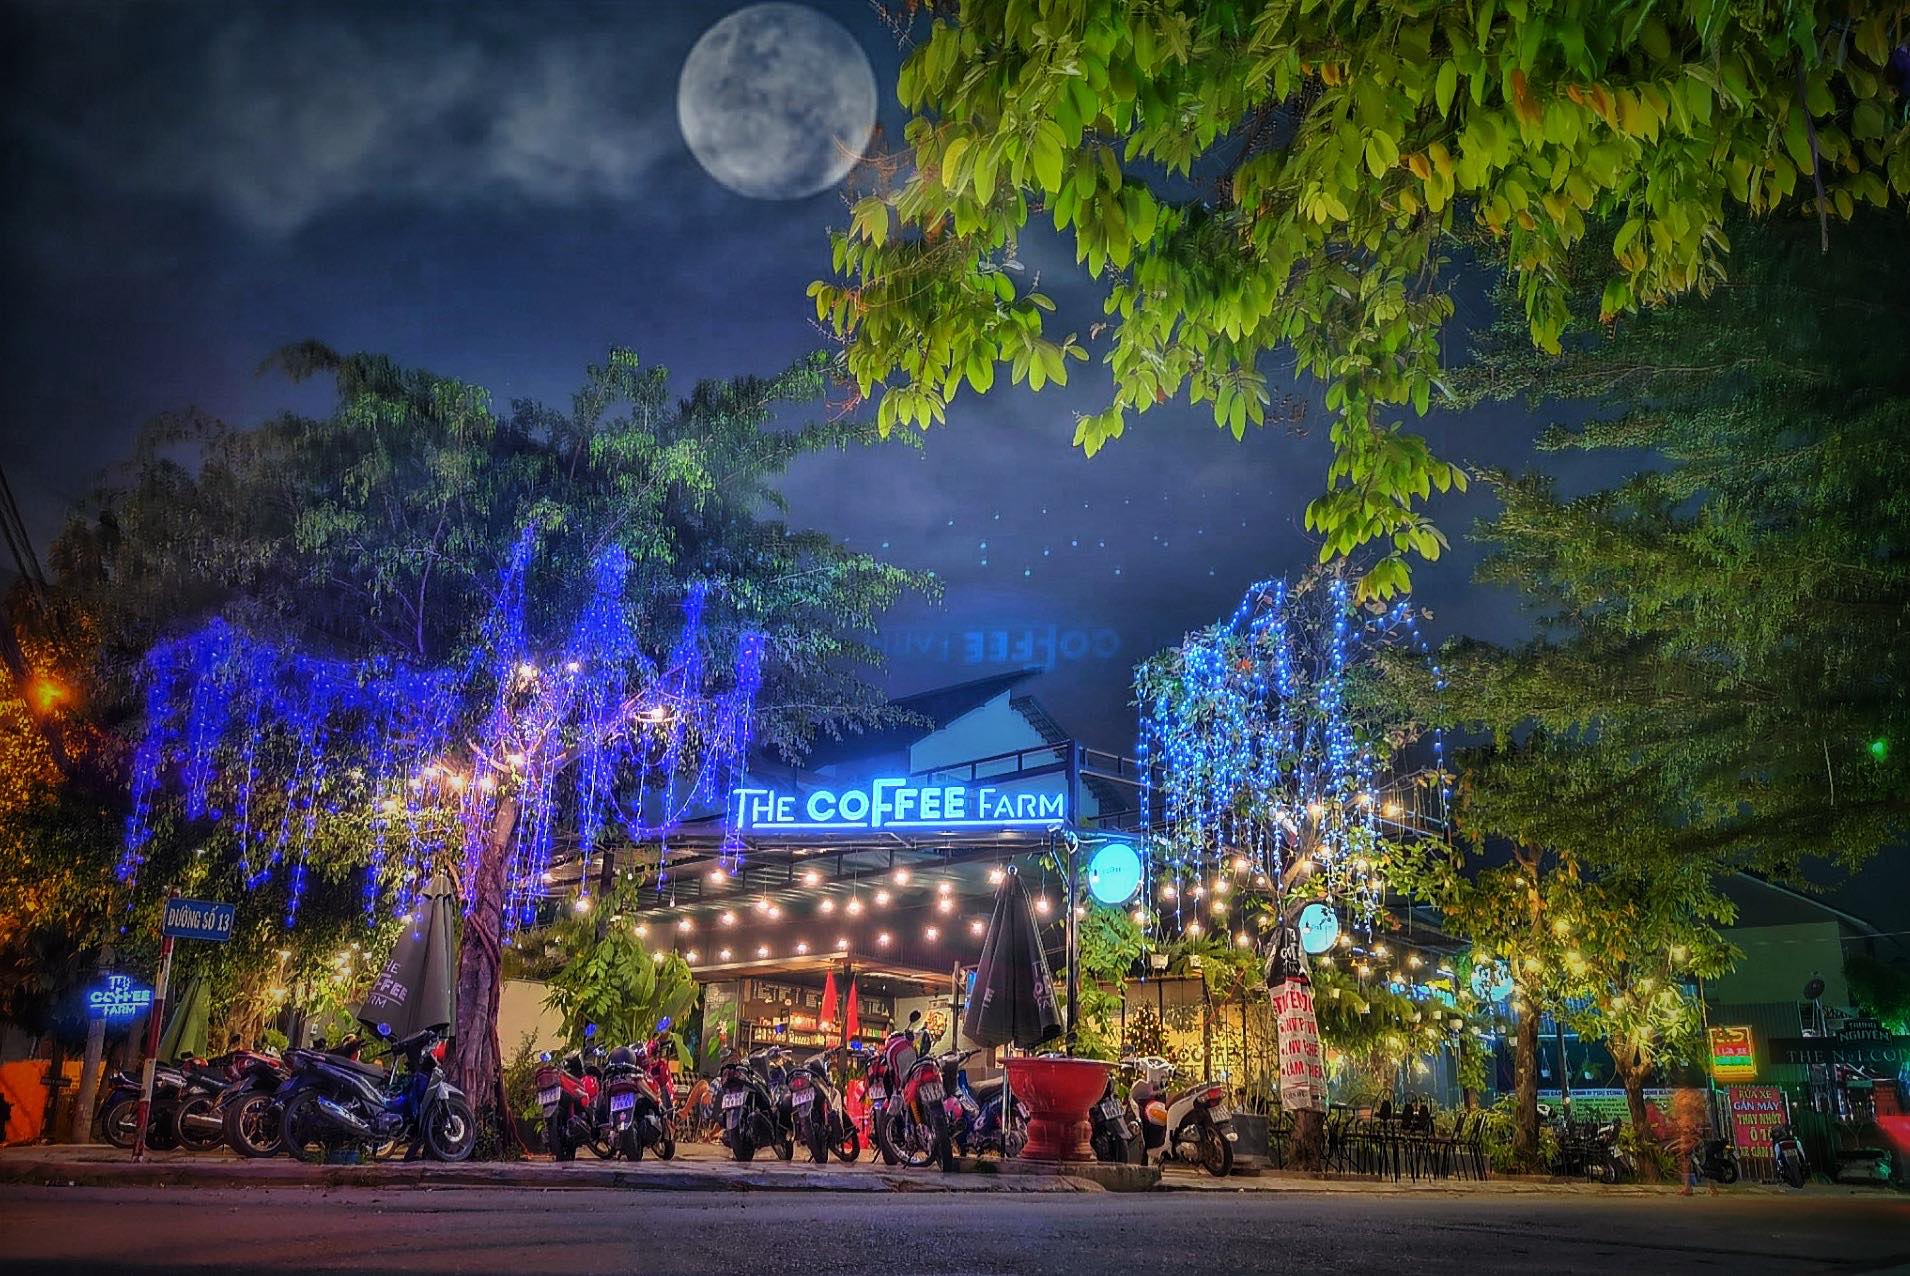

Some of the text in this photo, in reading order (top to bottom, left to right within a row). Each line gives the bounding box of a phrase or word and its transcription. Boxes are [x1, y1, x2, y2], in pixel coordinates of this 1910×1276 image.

[733, 778, 1064, 829] THE COFFEE FARM
[202, 905, 219, 931] SỐ
[217, 912, 231, 932] 13
[1786, 1049, 1824, 1063] THE
